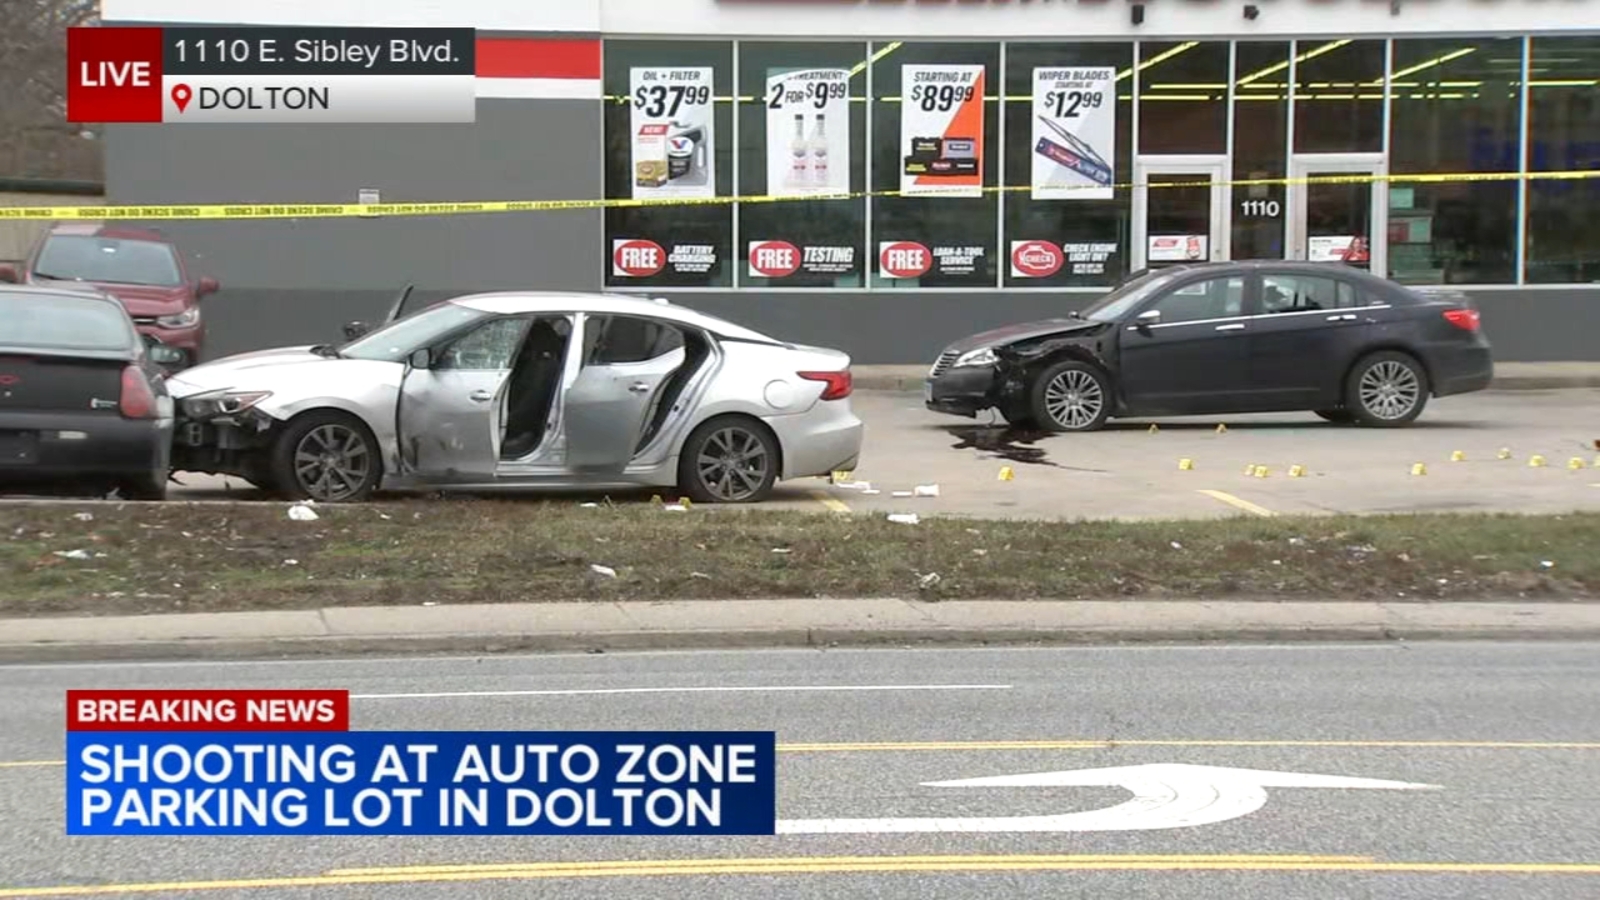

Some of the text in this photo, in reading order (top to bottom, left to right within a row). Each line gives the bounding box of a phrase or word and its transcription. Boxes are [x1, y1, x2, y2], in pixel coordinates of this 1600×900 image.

[643, 71, 659, 81] OIL
[670, 71, 701, 81] FILTER
[914, 72, 972, 82] STARTING AT
[1039, 71, 1110, 80] WIPER BLADES
[769, 82, 784, 109] 2
[785, 91, 804, 103] FOR
[1241, 200, 1280, 217] 1110
[621, 248, 658, 269] FREE
[756, 248, 793, 269] FREE
[804, 246, 854, 262] TESTING
[887, 249, 924, 270] FREE
